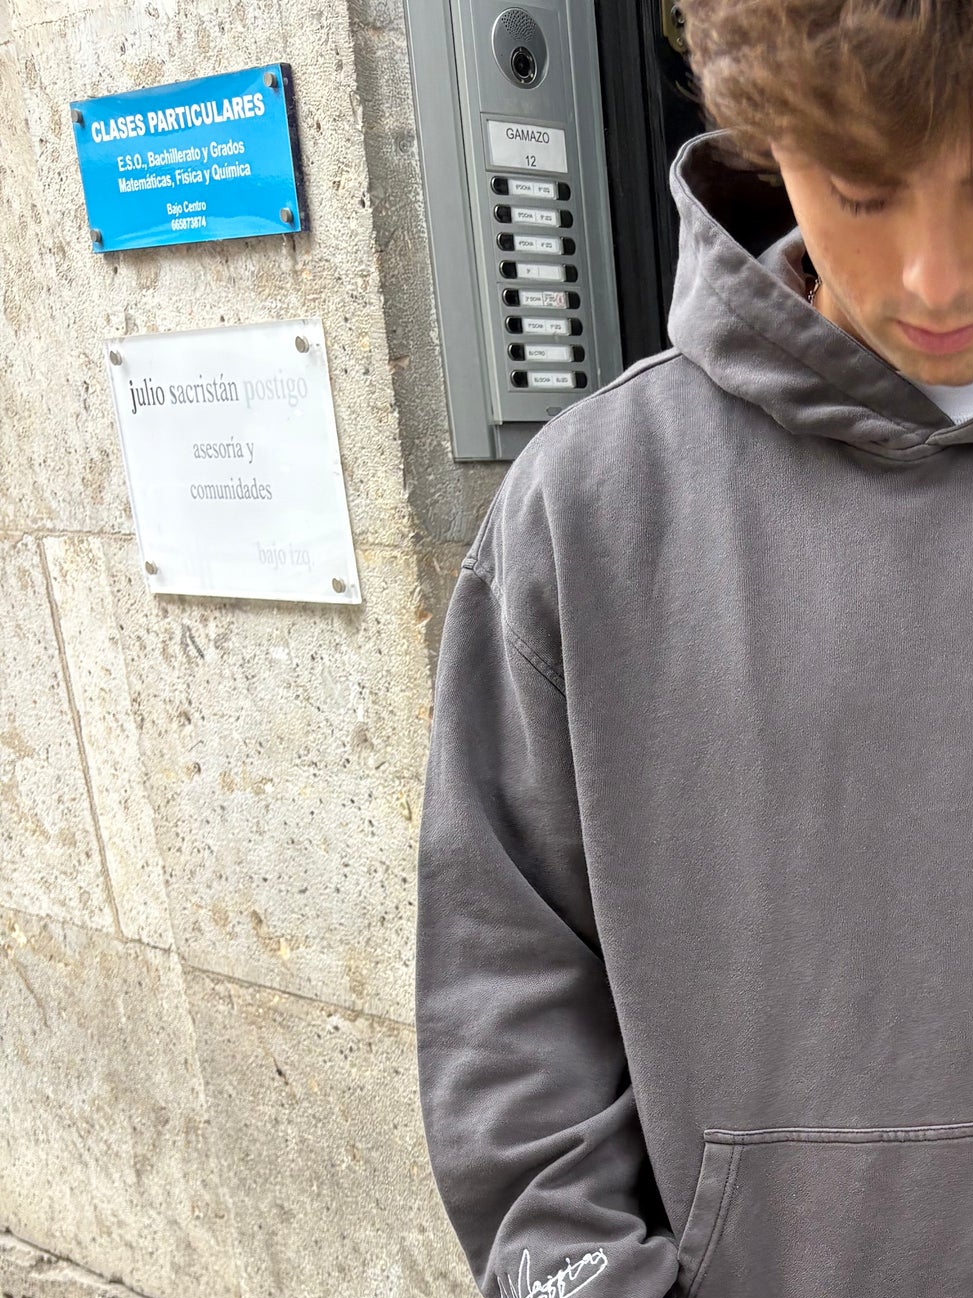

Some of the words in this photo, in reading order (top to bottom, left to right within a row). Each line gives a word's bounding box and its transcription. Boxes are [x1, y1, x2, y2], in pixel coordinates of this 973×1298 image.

[91, 114, 146, 143] CLASES
[148, 92, 265, 134] PARTICULARES
[506, 127, 550, 144] GAMAZO
[147, 146, 201, 168] Bachillerato
[201, 148, 208, 163] y
[210, 139, 245, 157] Grados
[525, 155, 537, 167] 12
[118, 171, 175, 193] Matemáticas,
[176, 168, 203, 185] Física
[204, 170, 211, 185] y
[212, 161, 251, 181] Química
[167, 202, 183, 217] Bajo
[184, 201, 207, 212] Centro
[129, 379, 166, 415] julio
[169, 373, 239, 405] sacristán
[244, 368, 308, 408] postigo
[193, 437, 243, 459] asesoría
[244, 441, 255, 464] y
[190, 478, 273, 500] comunidades
[257, 541, 287, 567] bajo
